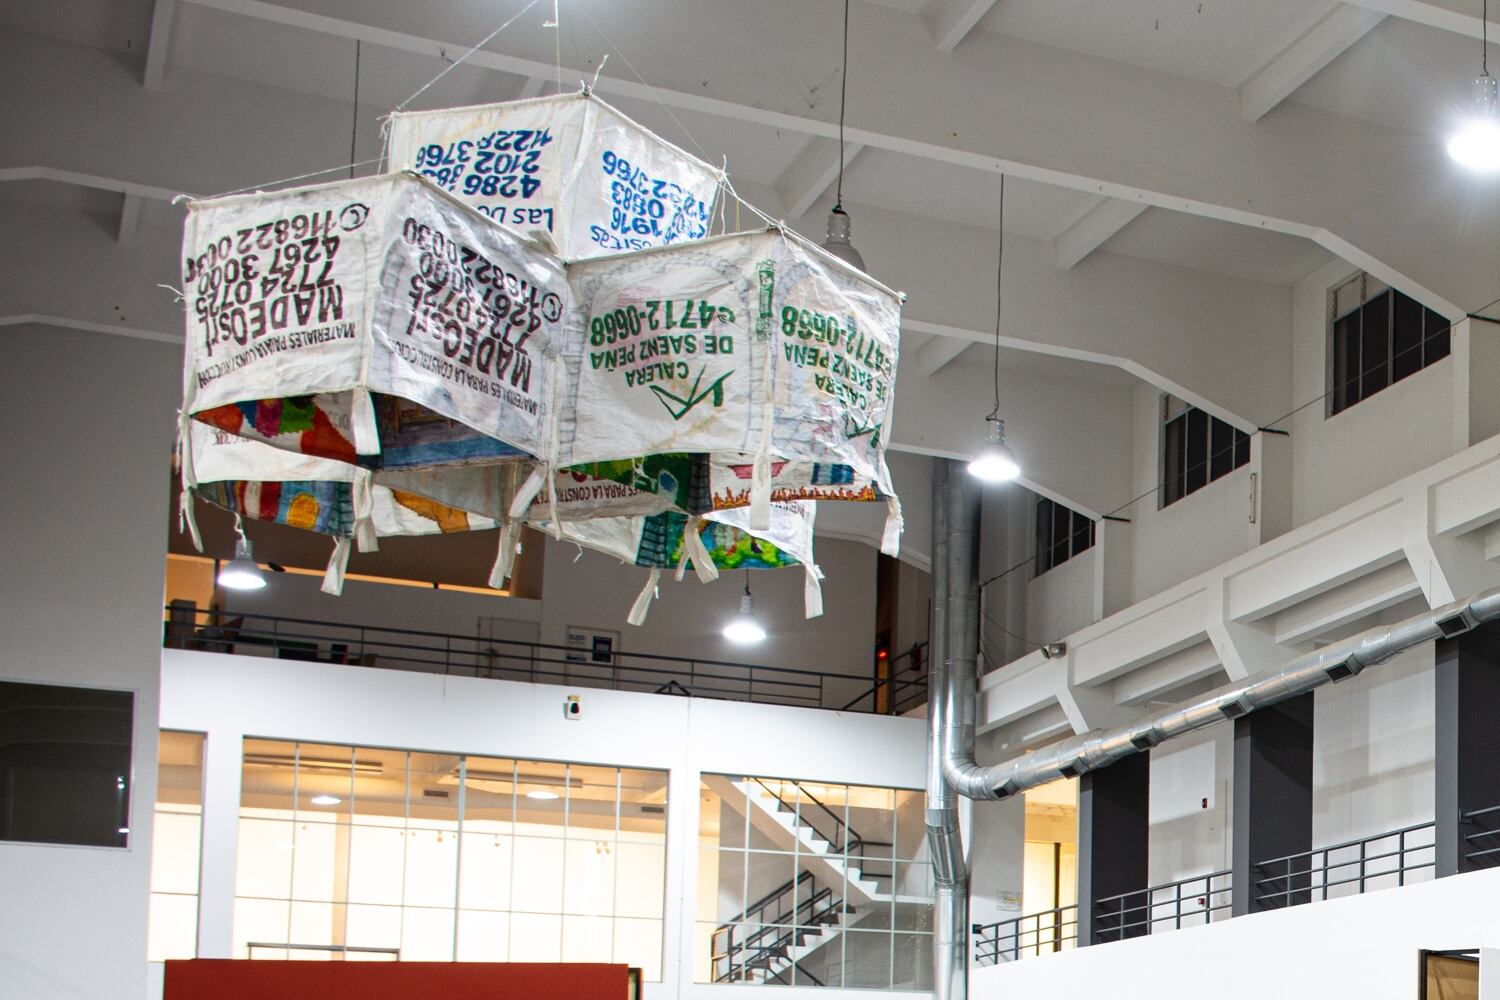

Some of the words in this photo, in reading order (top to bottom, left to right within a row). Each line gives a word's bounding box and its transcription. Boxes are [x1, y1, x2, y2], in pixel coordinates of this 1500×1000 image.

[416, 140, 474, 168] 3766
[474, 150, 541, 174] 2102
[462, 174, 541, 199] 4286
[237, 210, 336, 255] 116822
[512, 207, 553, 233] Las
[611, 206, 662, 237] 1916
[269, 235, 340, 275] 4267
[403, 217, 458, 265] 0030
[199, 254, 259, 296] 3000
[261, 260, 336, 297] 7724
[196, 280, 252, 323] 0725
[290, 322, 355, 350] MATERIALES
[590, 299, 716, 347] 4712-0668
[590, 343, 636, 373] PEÑA
[639, 334, 698, 361] SAENZ
[704, 335, 734, 354] DE
[784, 342, 830, 369] PEÑA
[625, 361, 690, 387] CALERA
[592, 486, 603, 499] LA
[605, 484, 627, 499] PARA
